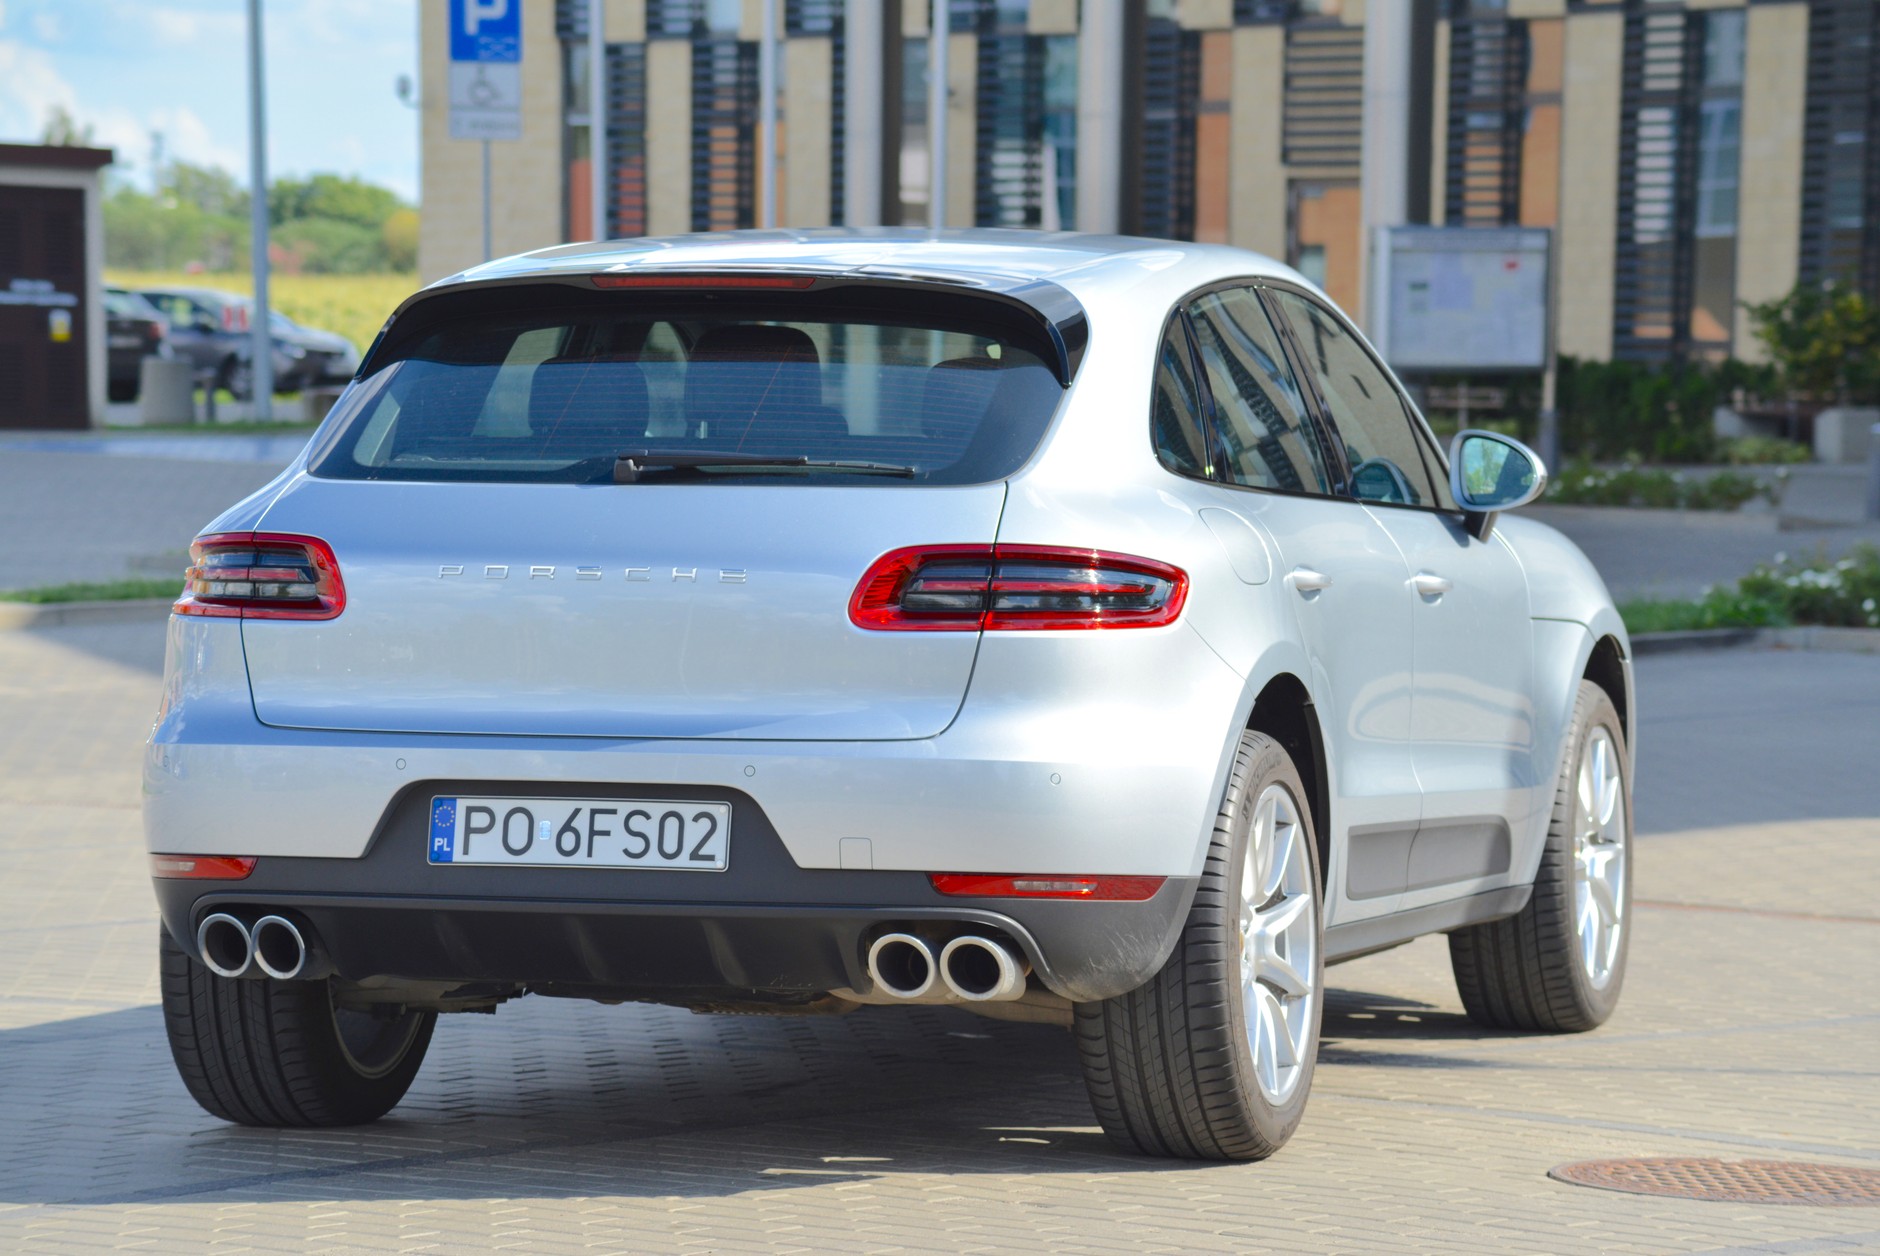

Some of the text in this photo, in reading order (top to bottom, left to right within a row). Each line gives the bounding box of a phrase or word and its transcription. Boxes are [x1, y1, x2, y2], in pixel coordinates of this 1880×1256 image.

[464, 0, 508, 36] P
[438, 565, 747, 583] PORSCHE
[434, 837, 451, 852] PL
[555, 807, 718, 861] 6FS02
